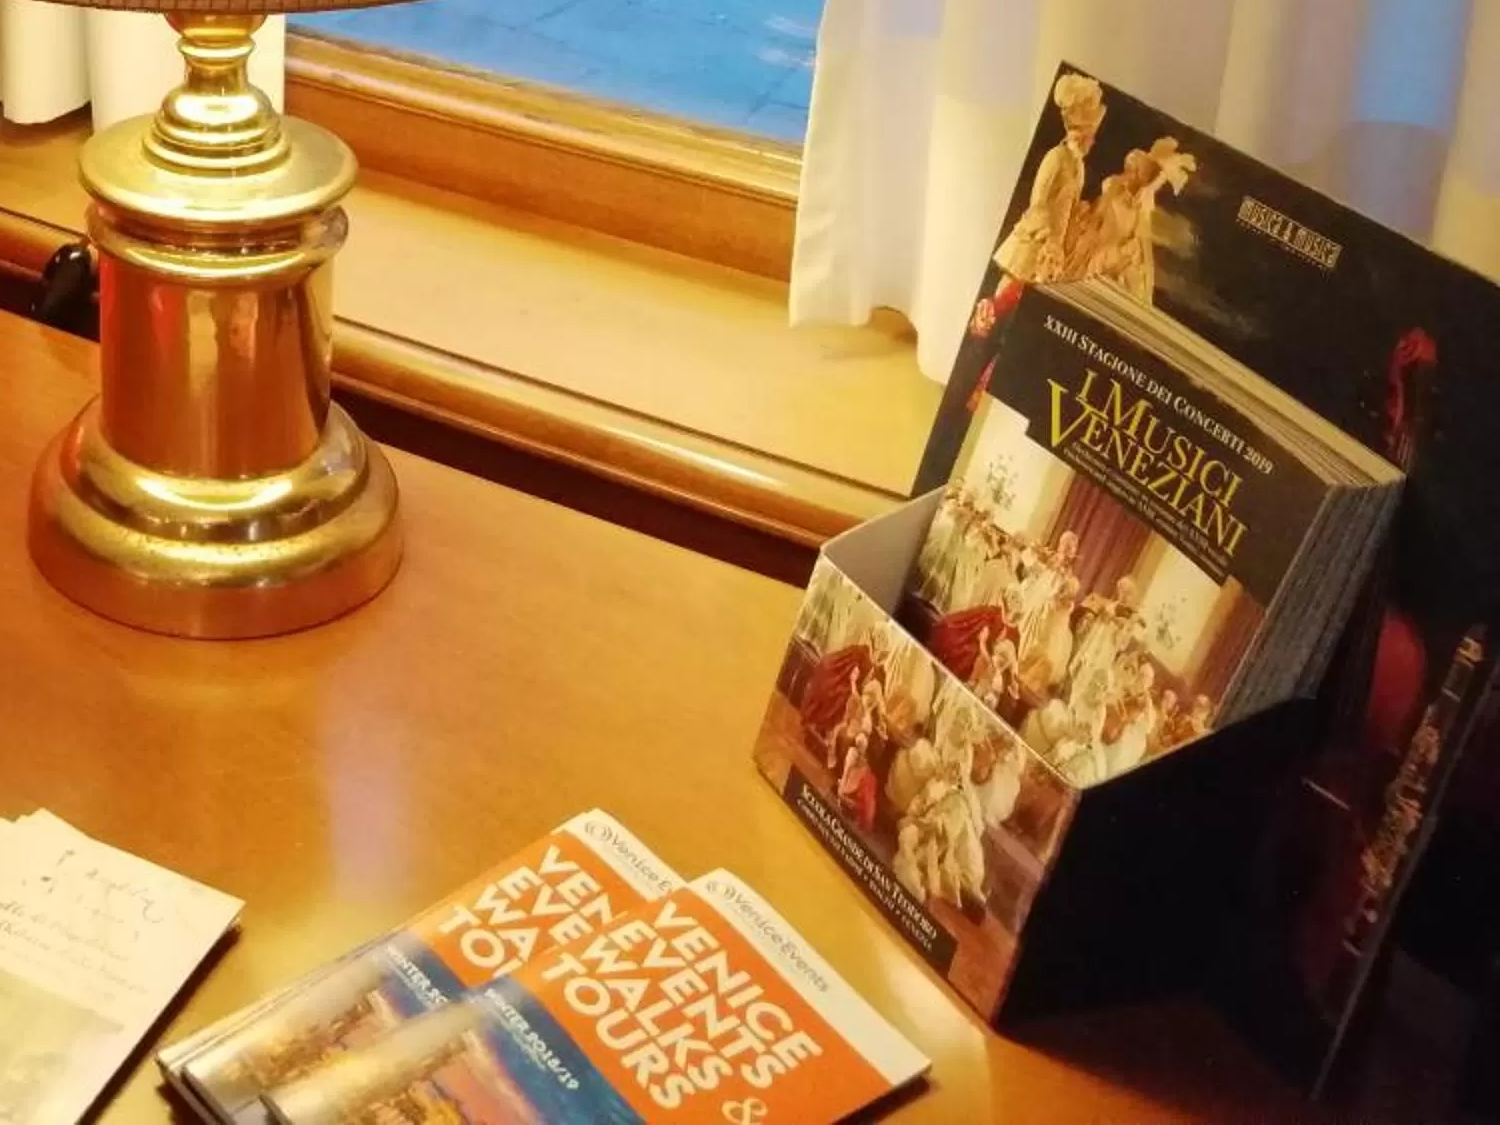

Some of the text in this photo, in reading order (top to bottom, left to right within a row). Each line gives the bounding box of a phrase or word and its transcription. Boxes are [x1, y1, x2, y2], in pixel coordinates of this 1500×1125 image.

[1047, 379, 1249, 557] VENEZIANI
[1078, 334, 1146, 388] STAGIONE
[1146, 380, 1173, 405] DEI
[1173, 395, 1246, 454] CONCERTI
[1243, 445, 1275, 474] 2019
[1100, 377, 1243, 508] MUSICI
[540, 952, 697, 1110] TOURS
[580, 934, 733, 1091] WALKS
[607, 919, 787, 1089] EVENTS
[654, 899, 824, 1069] VENICE
